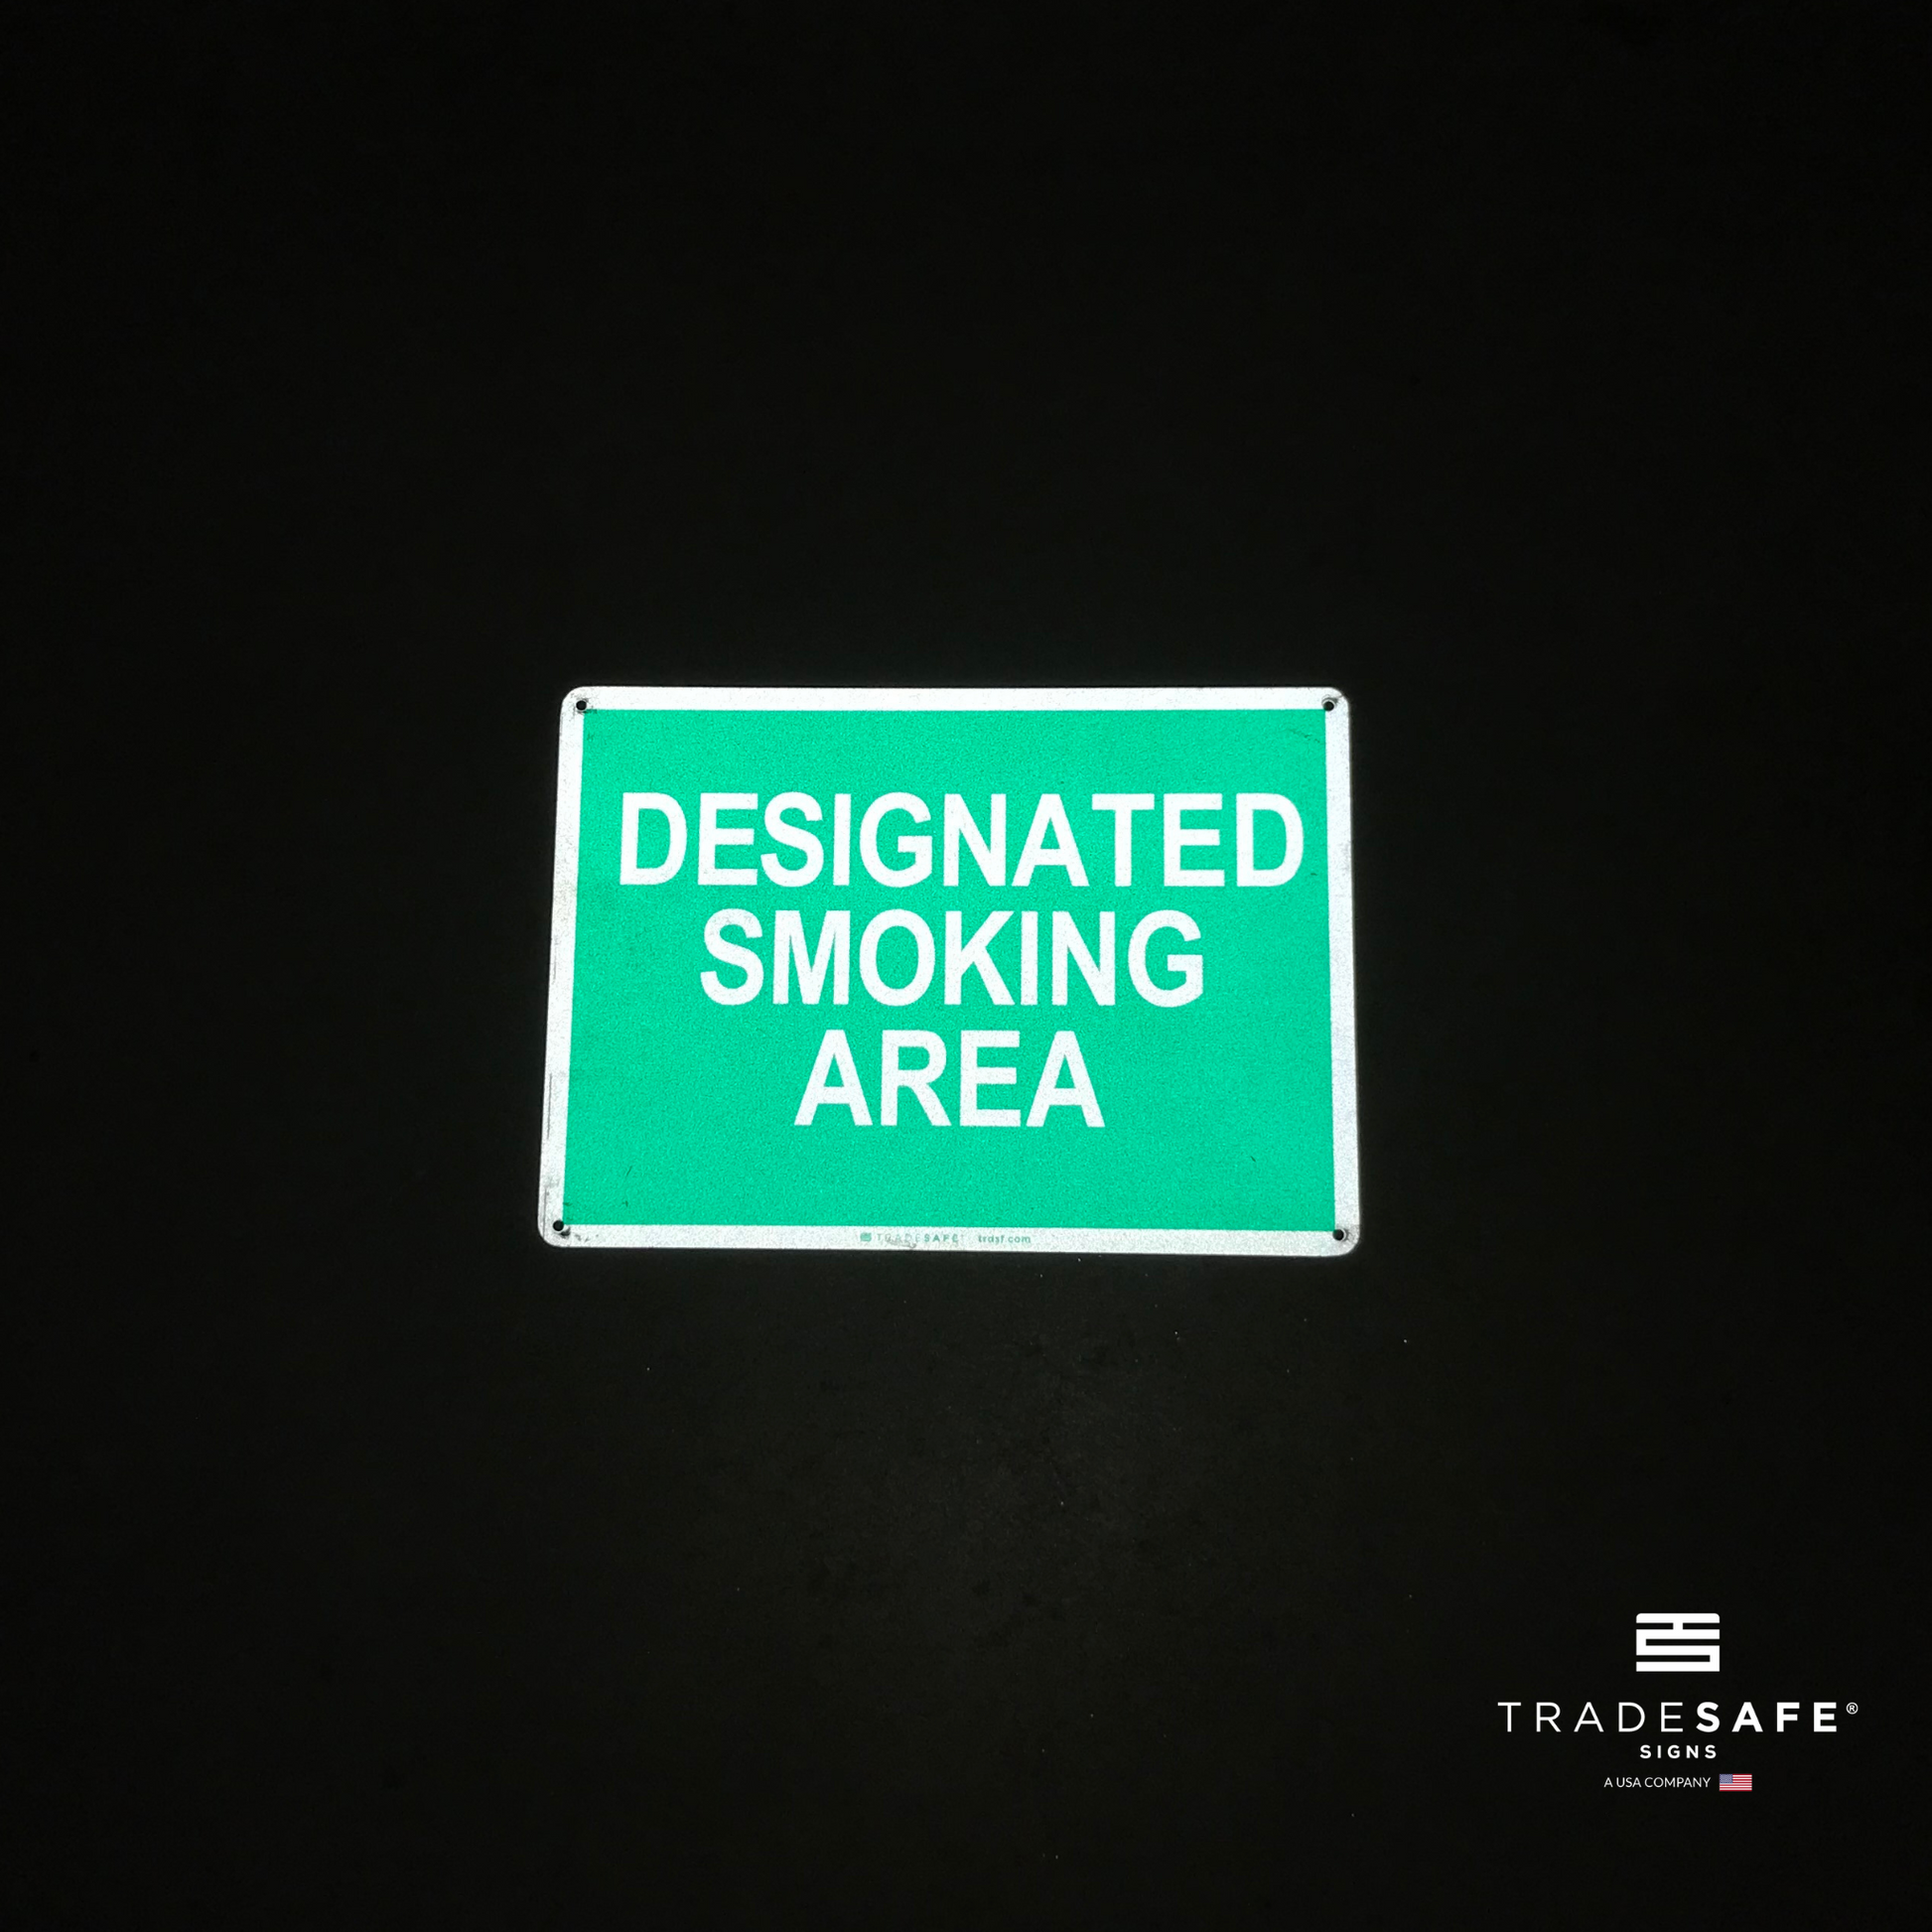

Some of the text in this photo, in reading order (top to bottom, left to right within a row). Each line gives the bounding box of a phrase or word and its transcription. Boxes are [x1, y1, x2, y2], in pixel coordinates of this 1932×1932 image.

[620, 791, 1305, 888] DESIGNATED
[701, 908, 1203, 1007] SMOKING
[794, 1030, 1105, 1127] AREA
